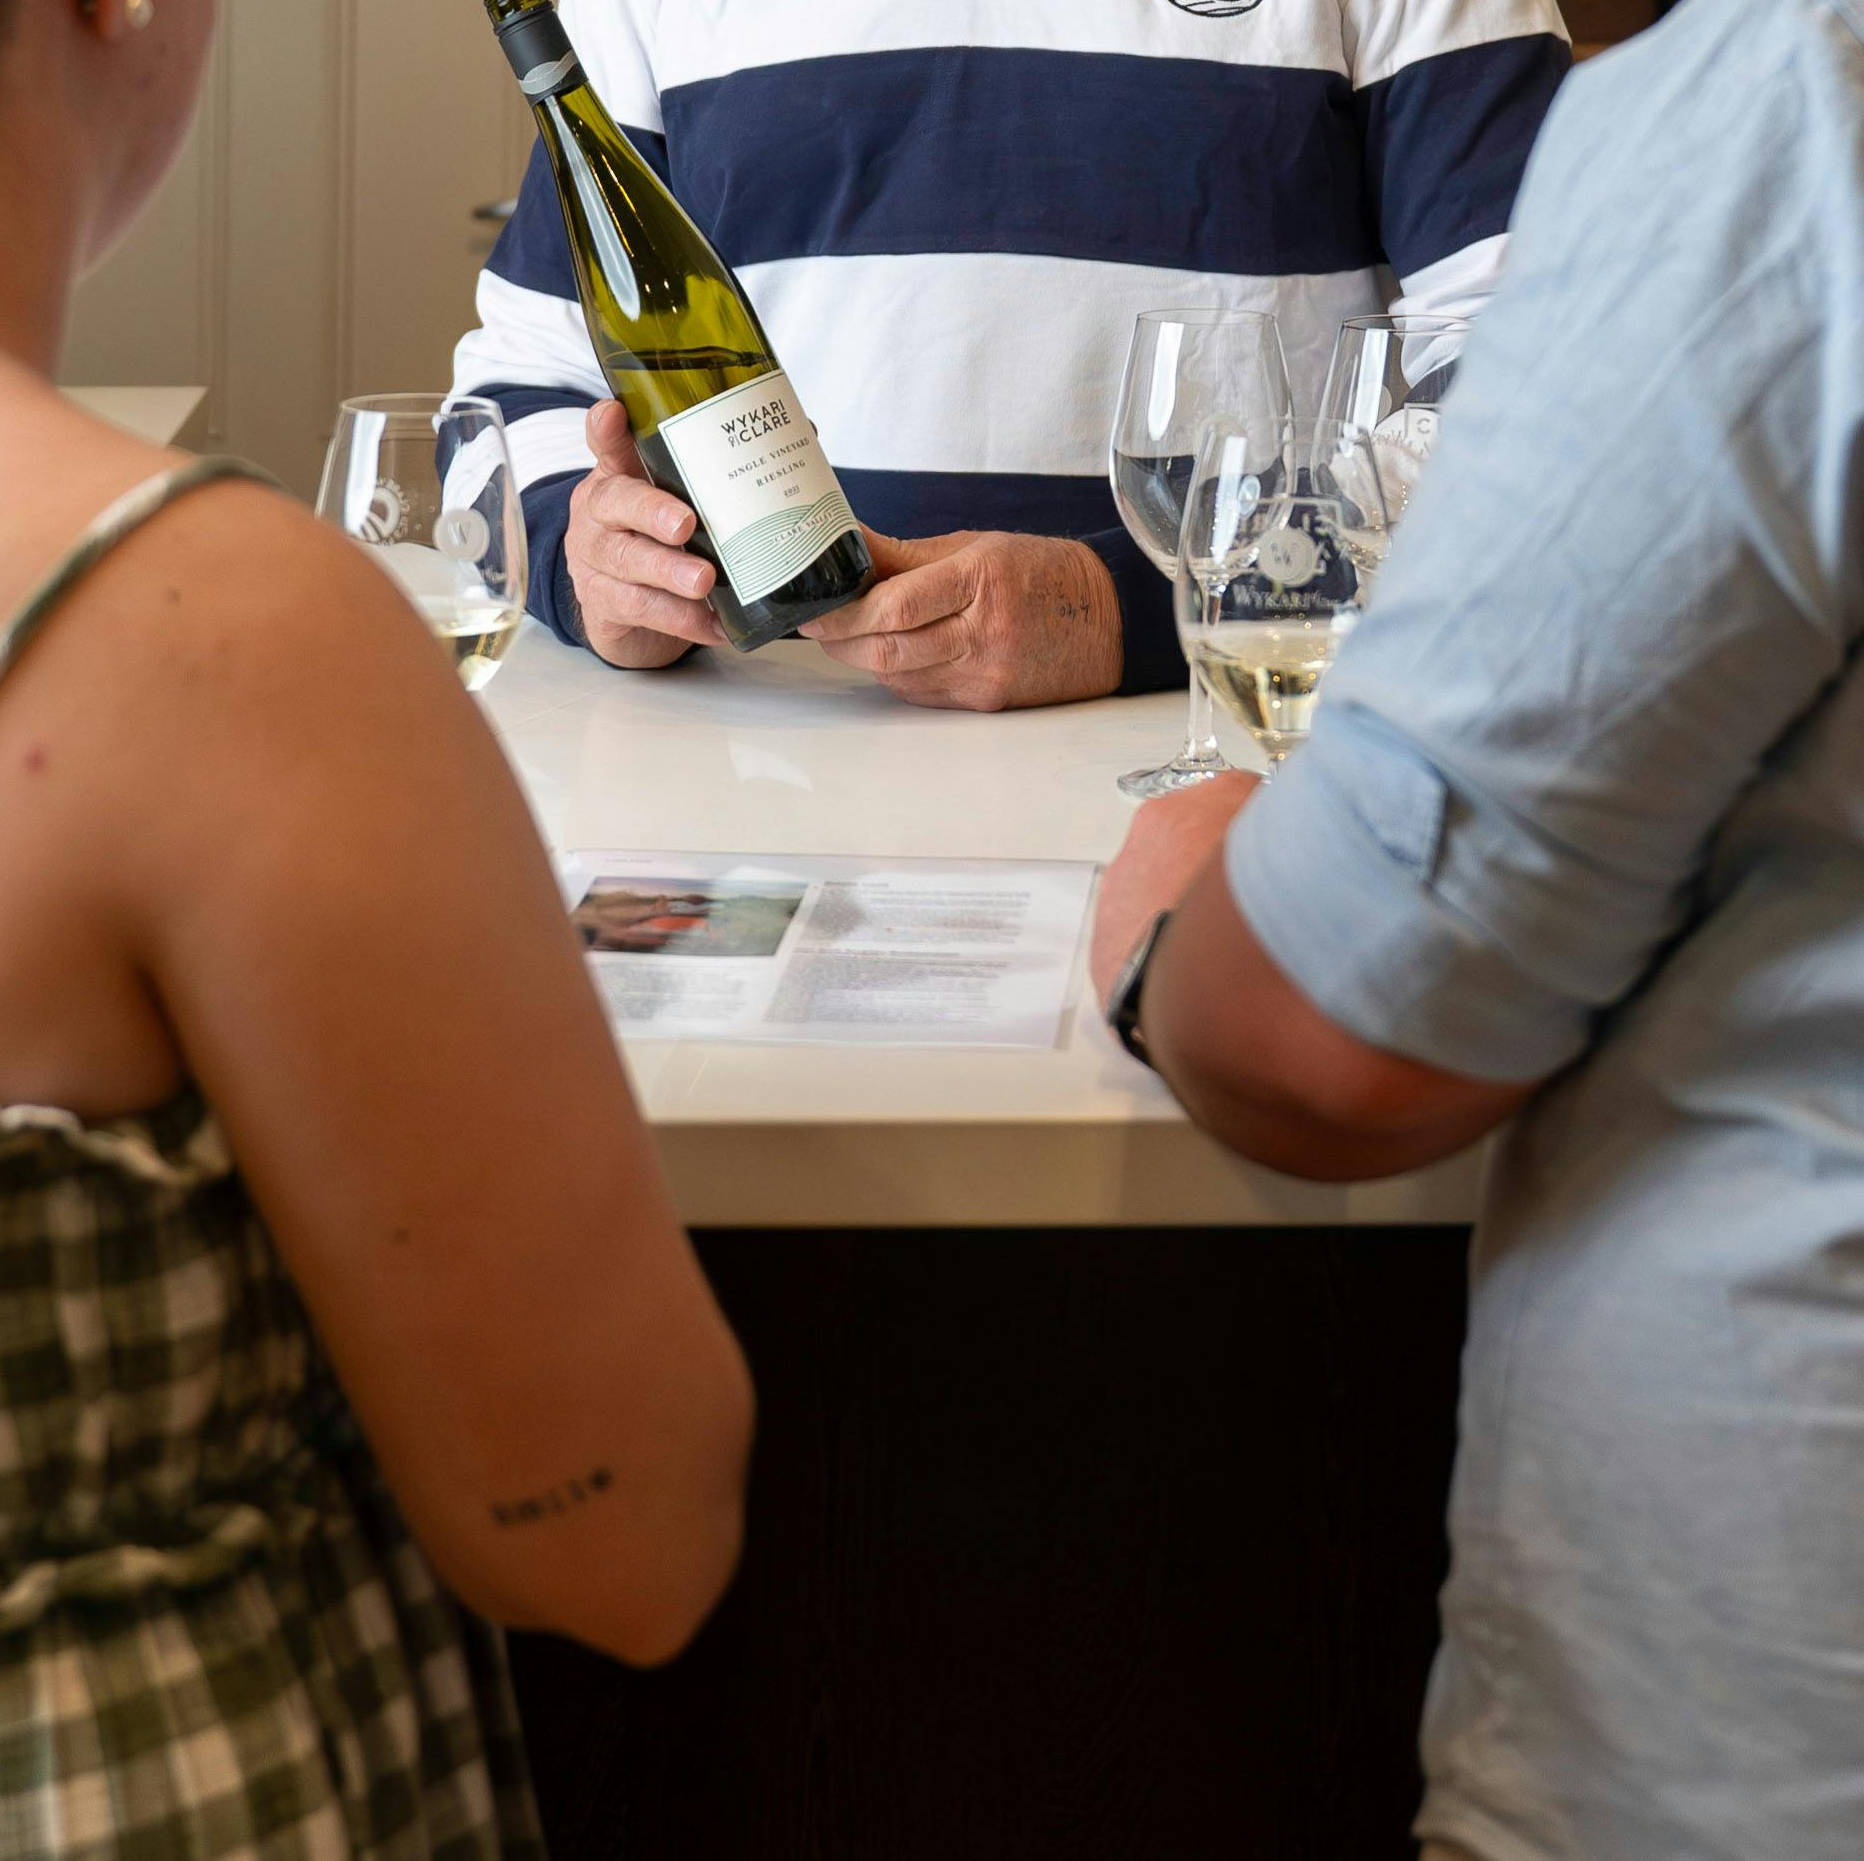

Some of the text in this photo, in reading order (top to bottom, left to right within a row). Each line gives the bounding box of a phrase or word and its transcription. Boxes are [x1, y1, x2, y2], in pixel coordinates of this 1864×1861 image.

[720, 398, 786, 436] WYKARI
[739, 411, 791, 444] CLARE
[728, 436, 811, 479] SINGLE VINEYARD
[755, 459, 806, 488] RIESLING
